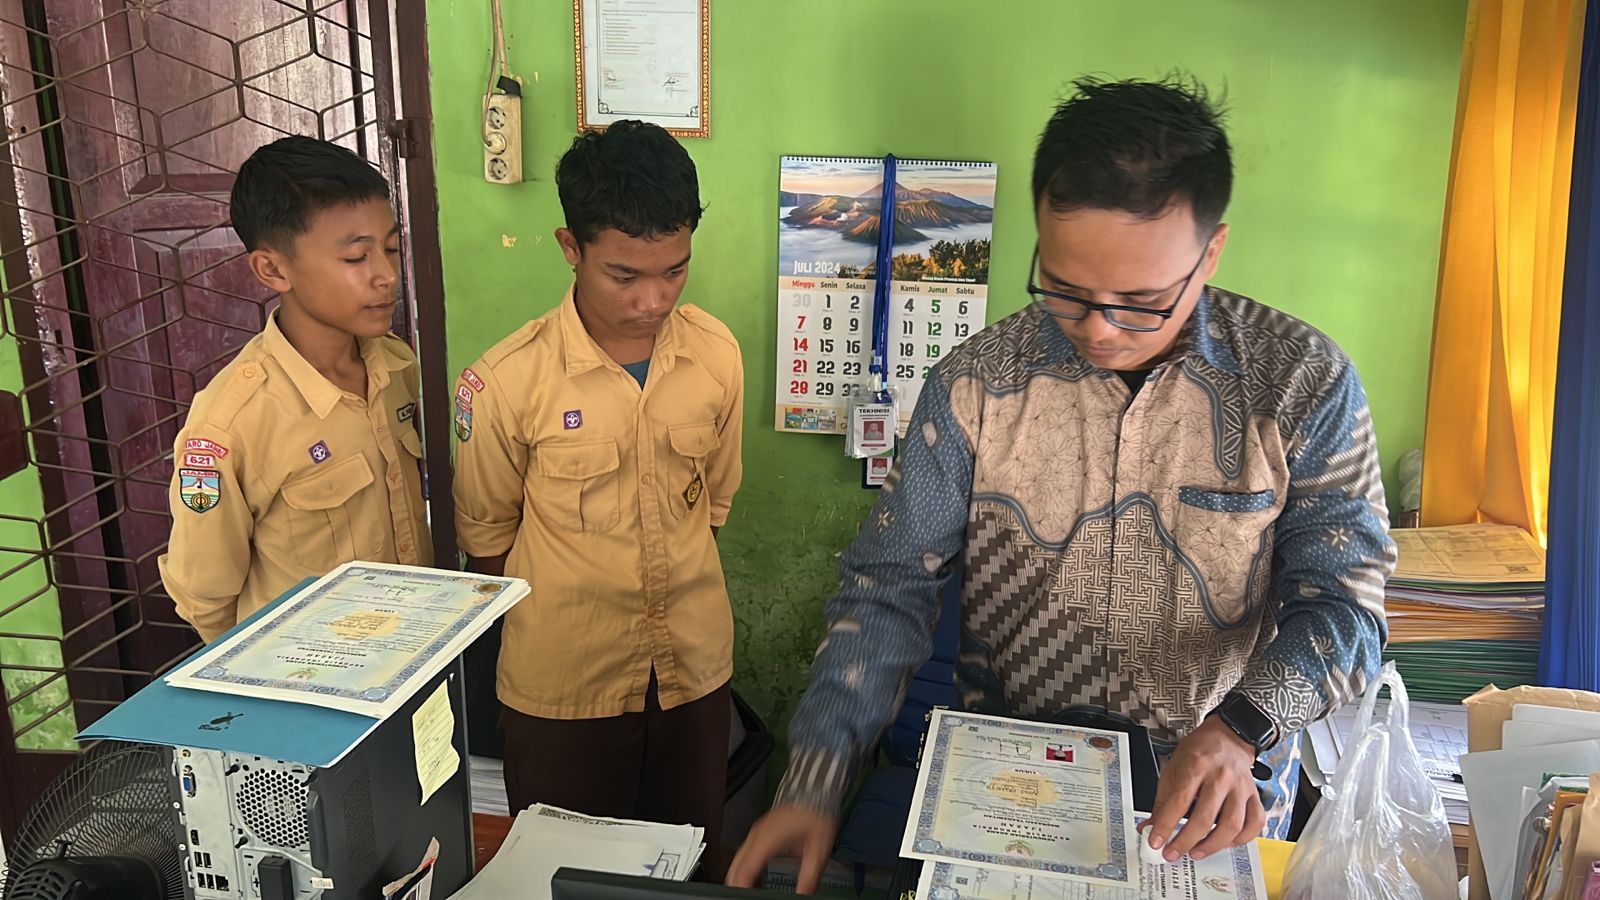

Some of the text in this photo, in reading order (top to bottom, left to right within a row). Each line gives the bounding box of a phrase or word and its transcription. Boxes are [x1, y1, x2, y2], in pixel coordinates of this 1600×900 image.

[793, 260, 841, 275] JULI 2024
[792, 279, 974, 295] Minggu Senin Selasa Kamis Jumat Sabtu
[826, 294, 831, 308] 1
[850, 295, 860, 309] 2
[904, 298, 914, 312] 4
[931, 299, 941, 314] 5
[958, 300, 968, 315] 6
[797, 315, 969, 337] 7 8 9 11 12 13
[793, 337, 941, 358] 14 15 16 18 19
[792, 359, 932, 379] 21 22 23 25 2
[790, 380, 809, 395] 28
[816, 382, 834, 395] 29
[204, 442, 224, 456] JAMBI
[190, 456, 210, 465] 621
